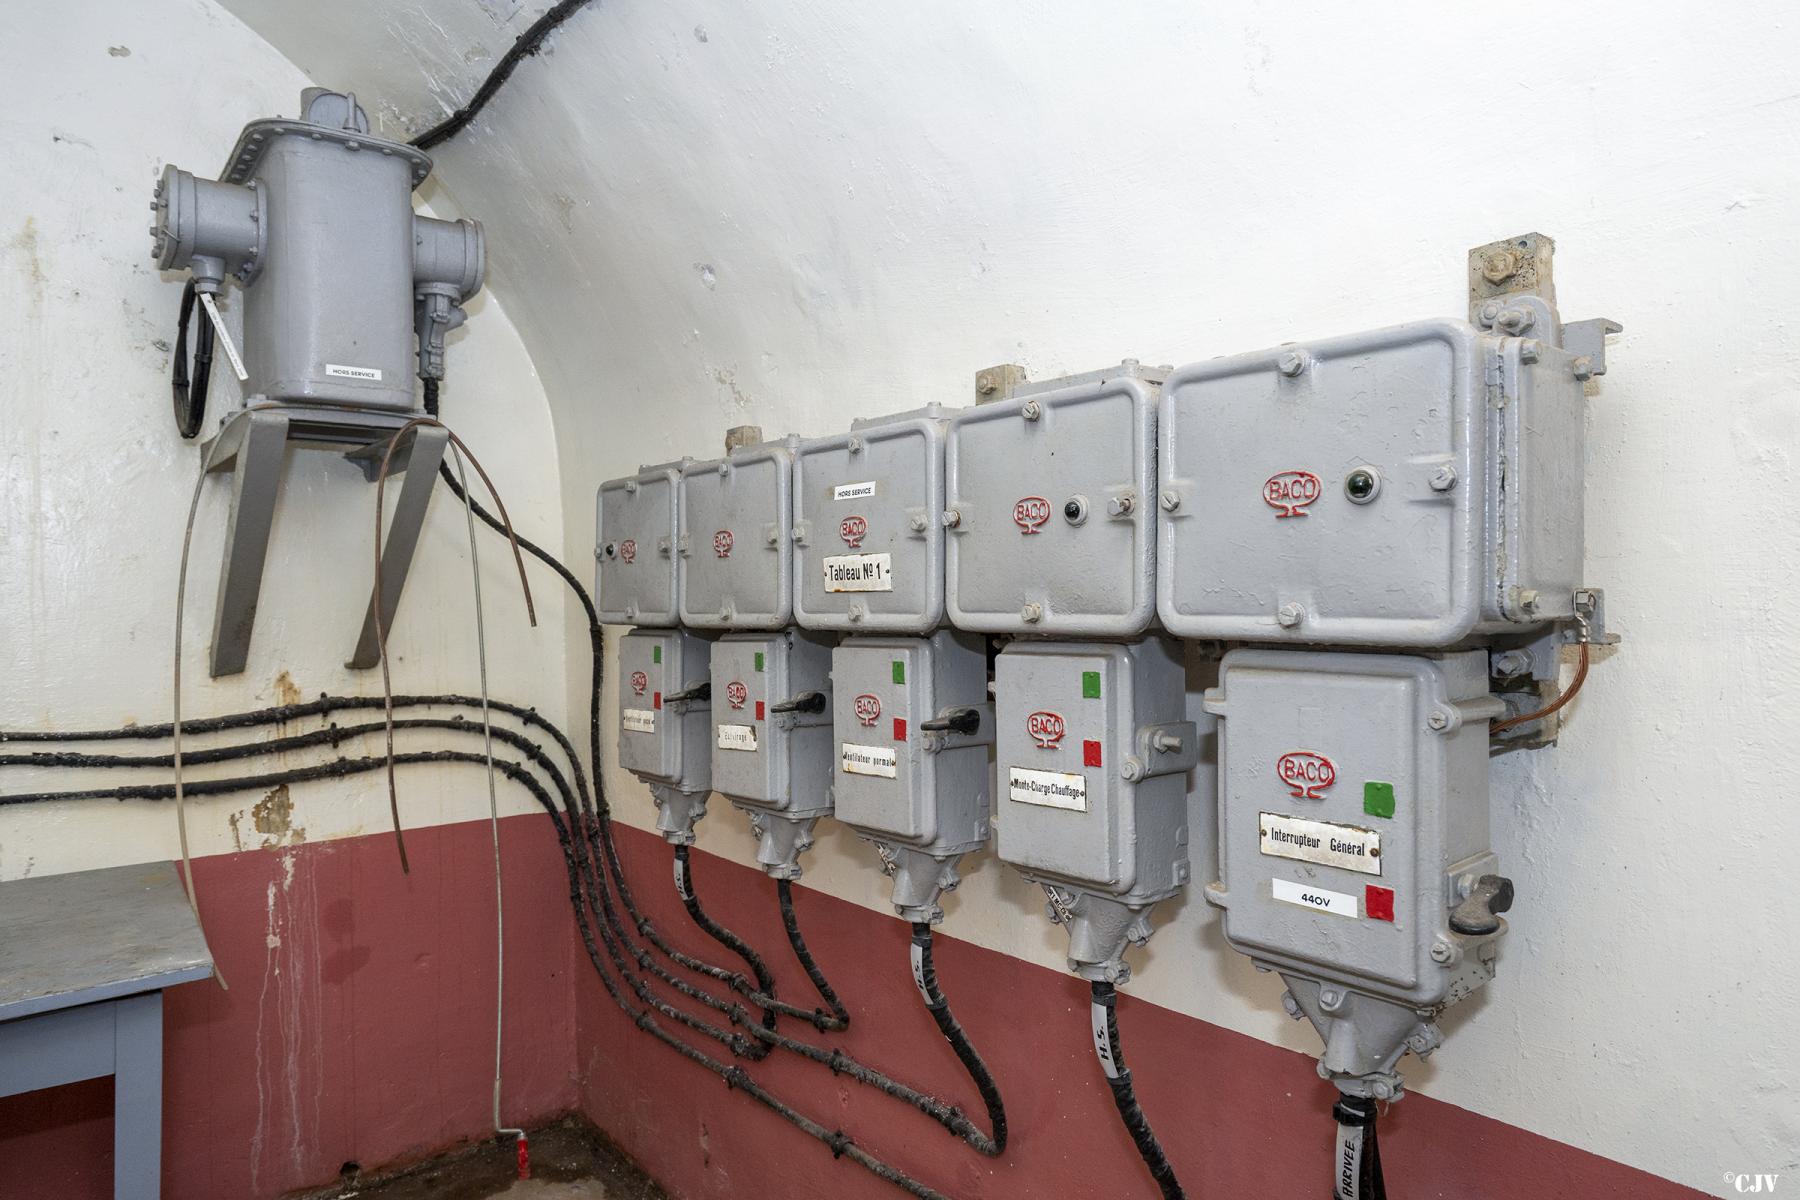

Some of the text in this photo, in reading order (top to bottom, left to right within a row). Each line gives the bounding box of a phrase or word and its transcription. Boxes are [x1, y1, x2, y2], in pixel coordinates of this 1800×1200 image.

[350, 370, 375, 378] SERVICE
[851, 487, 871, 496] SERVICE
[1270, 478, 1316, 501] BACO
[1017, 501, 1047, 521] BACO
[841, 520, 865, 537] BACO
[829, 564, 860, 581] Tableau
[875, 562, 881, 580] 1
[857, 700, 878, 715] BACO
[1031, 717, 1061, 735] BACO
[1284, 758, 1331, 783] BACO
[1013, 778, 1080, 800] Monte-Charge Chauffage
[1271, 827, 1365, 857] Interrupteur Général
[1301, 893, 1331, 907] 440V
[1096, 1025, 1109, 1061] H.S.
[1342, 1138, 1356, 1198] ARRIVEE
